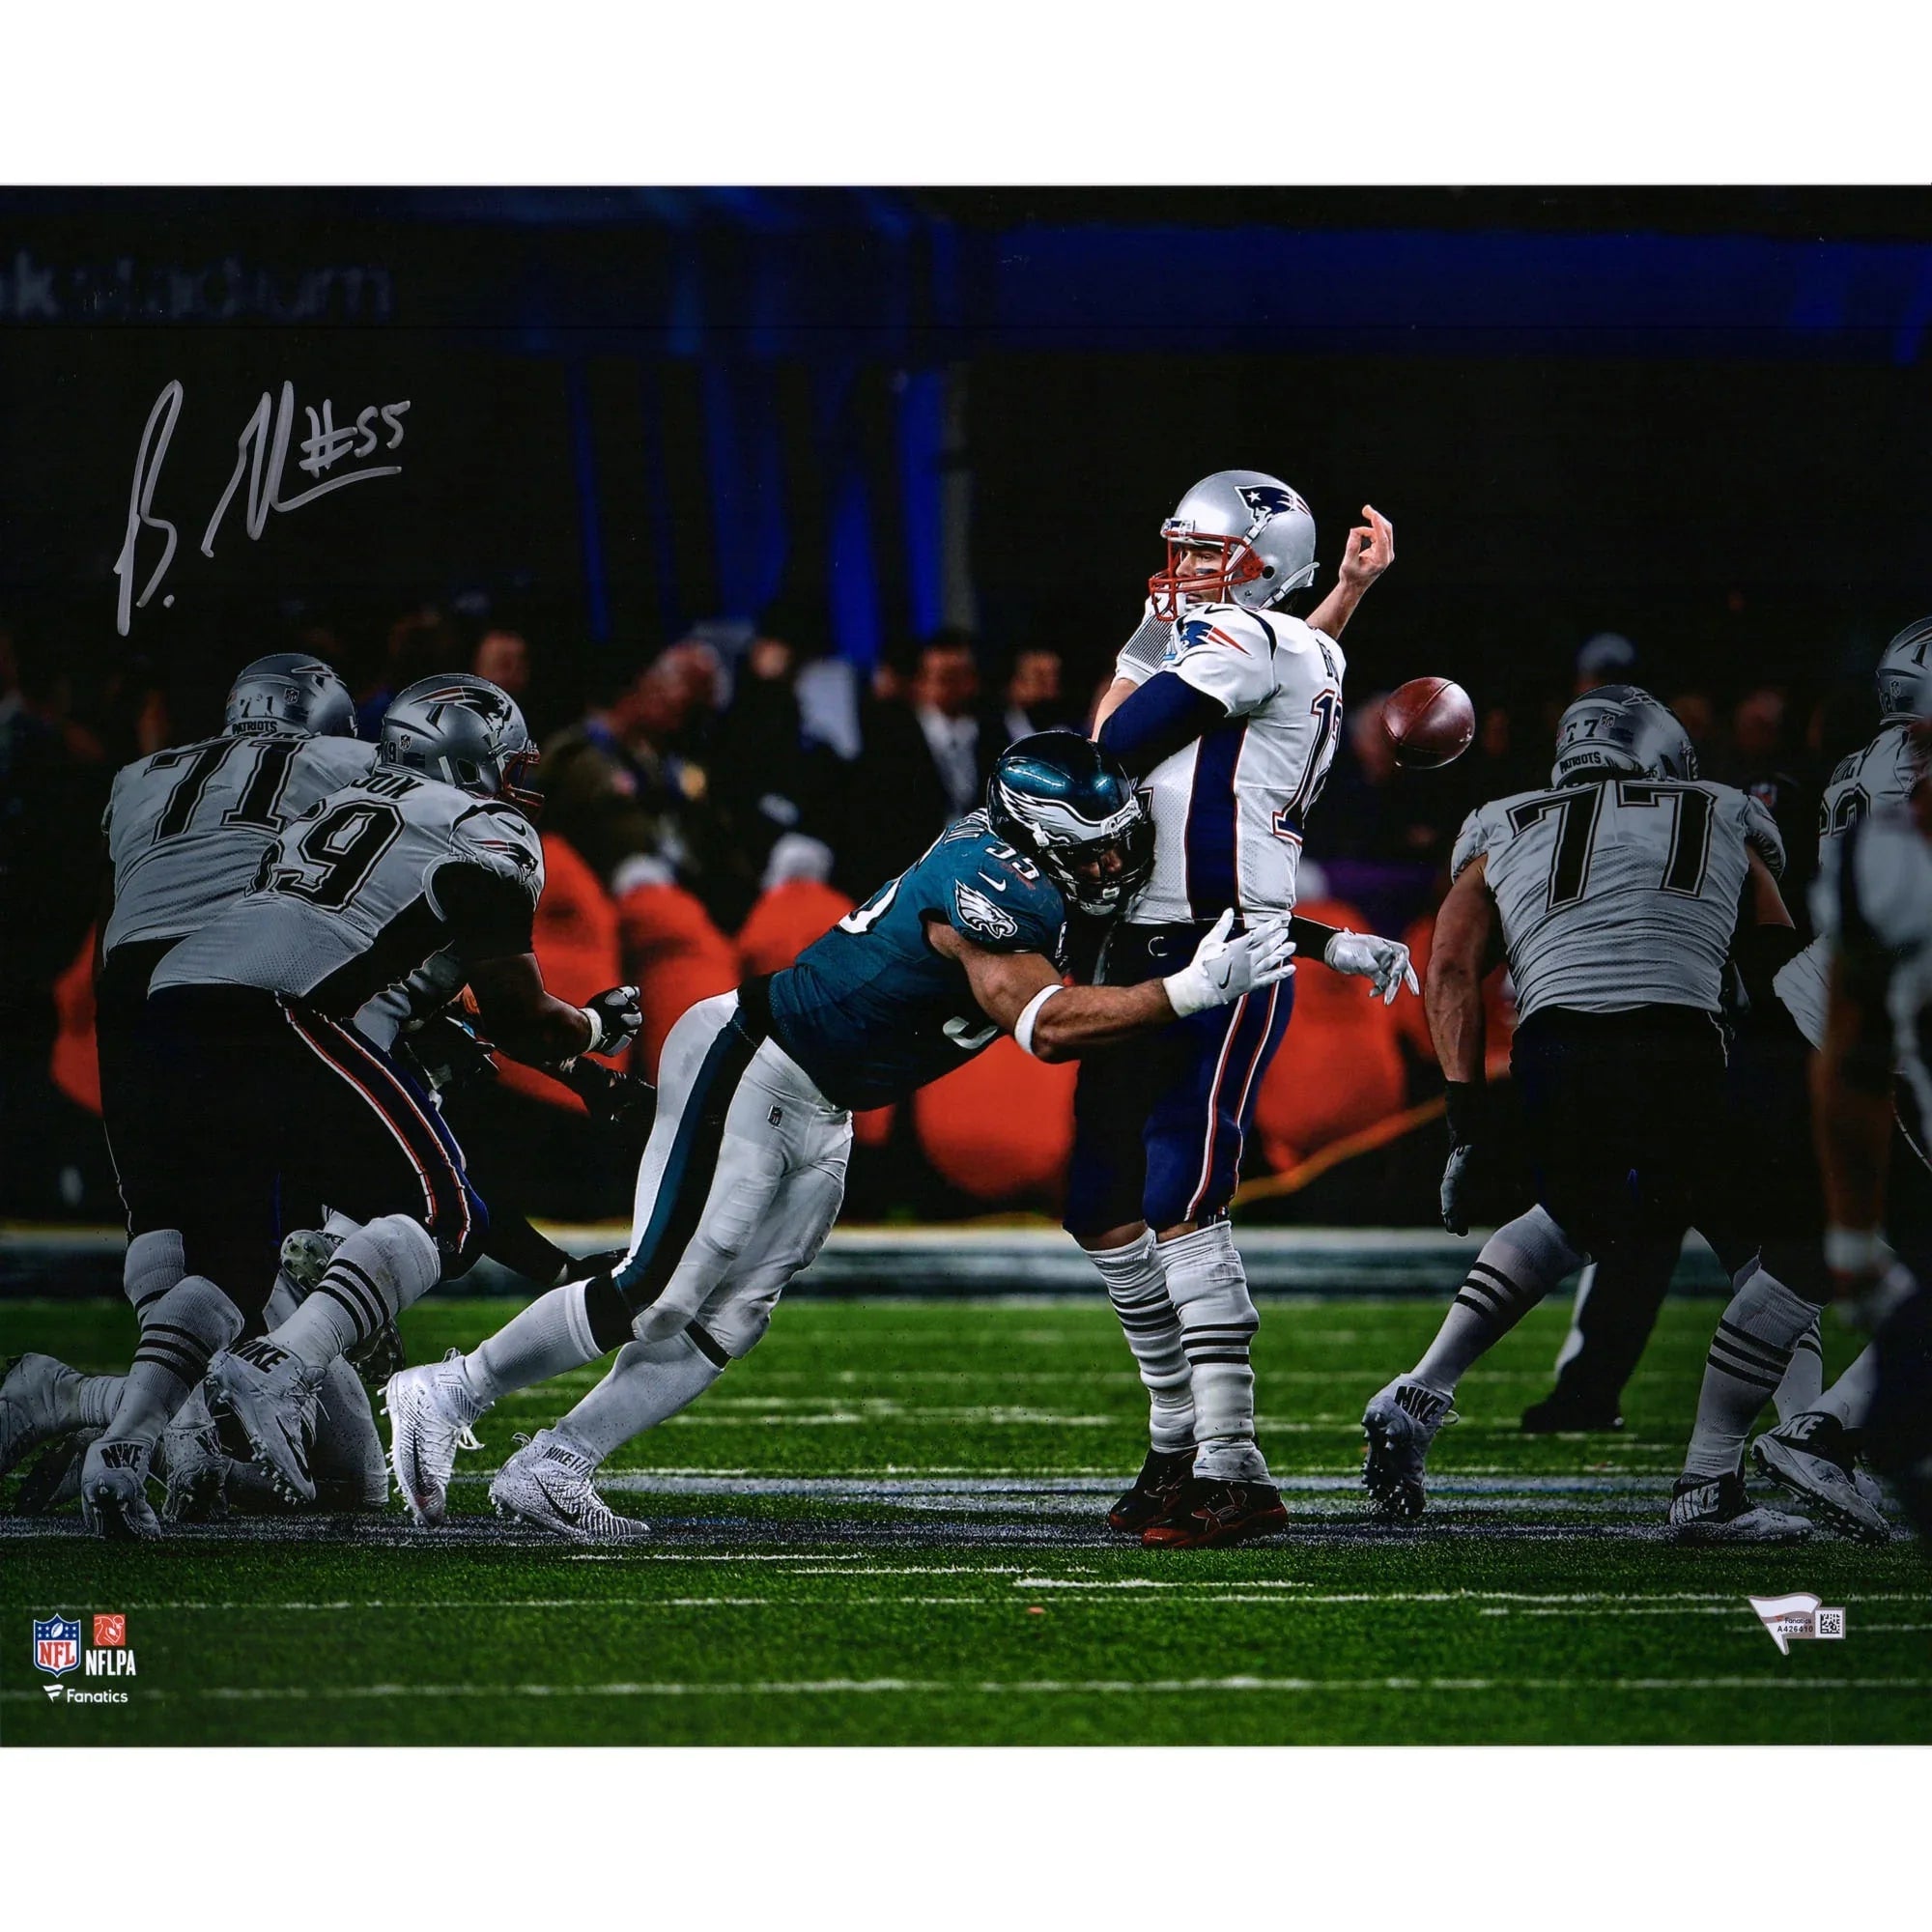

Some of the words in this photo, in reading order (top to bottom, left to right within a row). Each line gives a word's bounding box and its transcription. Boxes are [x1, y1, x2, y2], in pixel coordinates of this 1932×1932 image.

[232, 720, 277, 735] PATRIOTS
[1566, 719, 1600, 743] 77
[1559, 752, 1602, 775] PATRIOTS
[143, 739, 305, 847] 71
[1506, 780, 1719, 914] 77
[1394, 1385, 1446, 1426] NIKE
